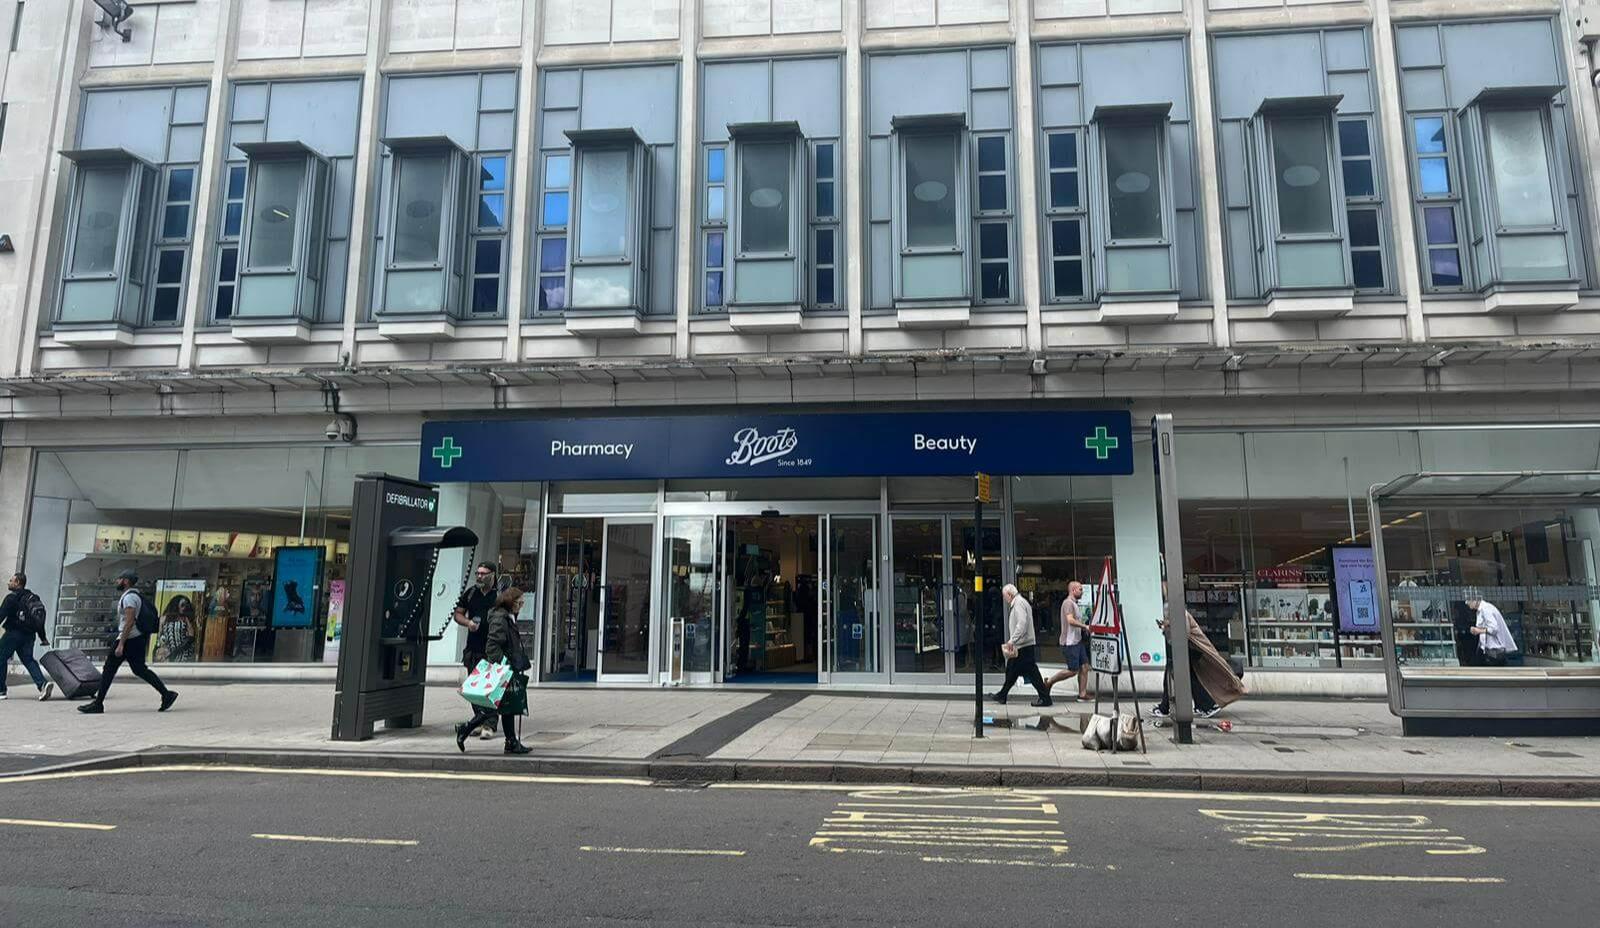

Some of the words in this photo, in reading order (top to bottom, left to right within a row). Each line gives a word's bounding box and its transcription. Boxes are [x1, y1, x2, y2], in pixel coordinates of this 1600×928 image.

[550, 440, 634, 459] Pharmacy
[725, 426, 799, 467] Boots
[913, 433, 978, 455] Beauty
[777, 458, 796, 467] Since
[797, 458, 813, 467] 1849
[386, 492, 428, 510] DEFIBRILLATOR
[1257, 569, 1302, 577] CLARINS
